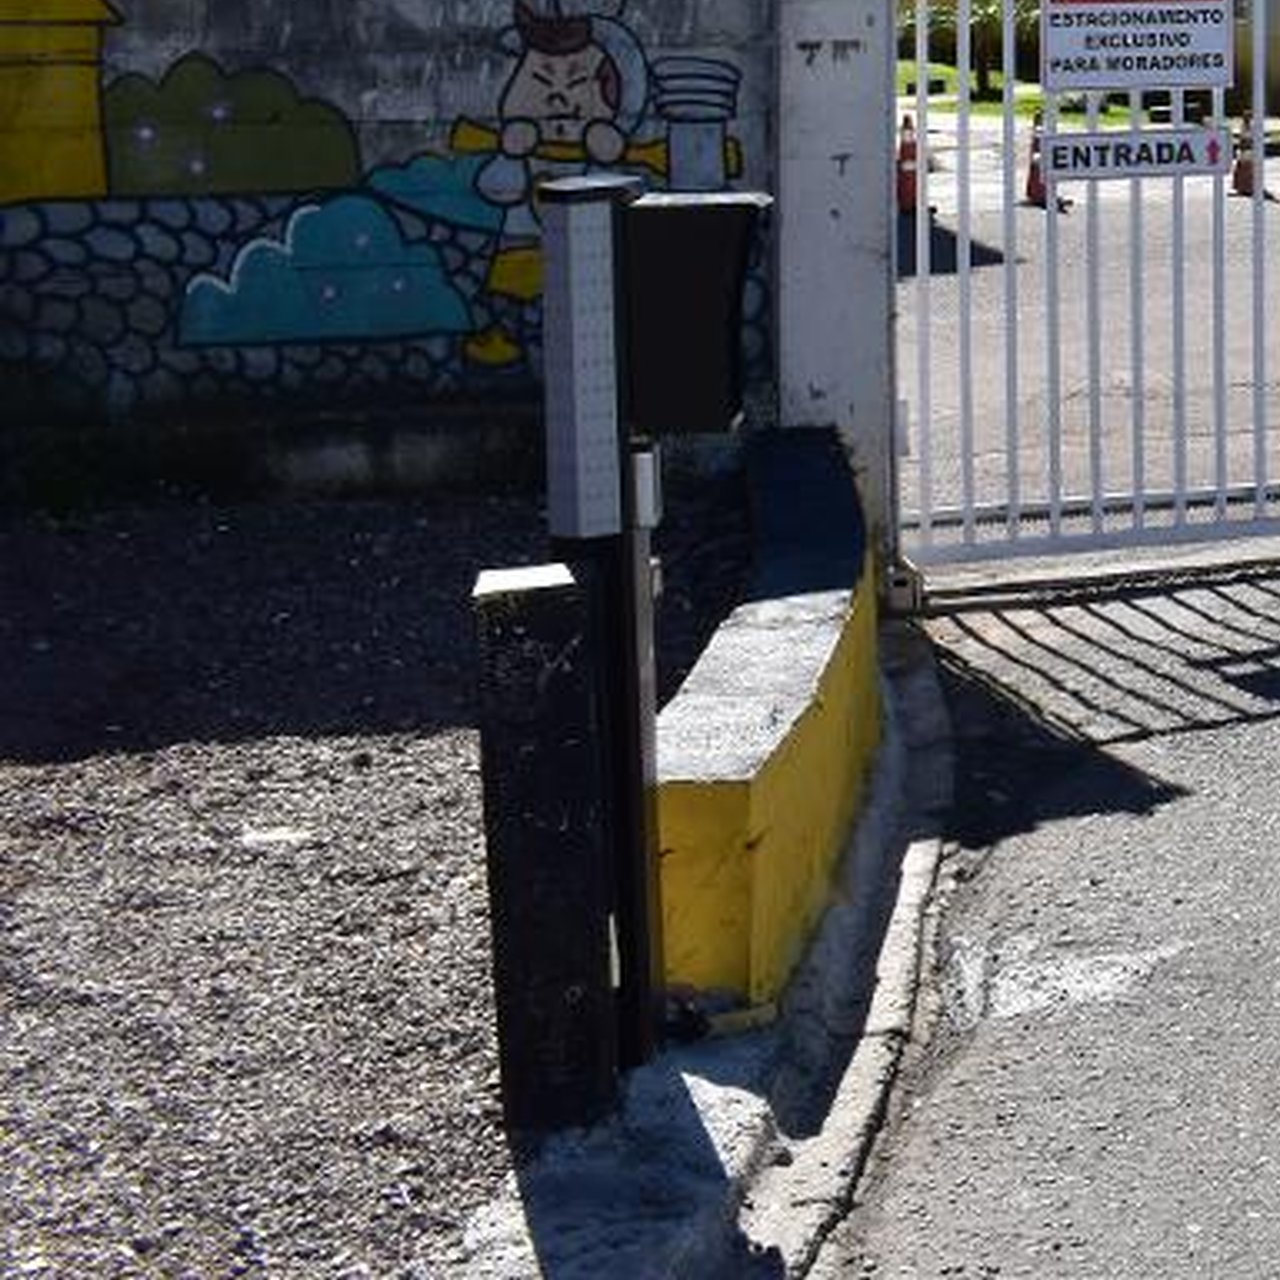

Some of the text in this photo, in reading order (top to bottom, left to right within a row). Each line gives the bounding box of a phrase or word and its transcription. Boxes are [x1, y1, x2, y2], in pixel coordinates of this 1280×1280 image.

[1050, 9, 1224, 28] ESTACIONAMENTO
[1084, 32, 1192, 50] EXCLUSIVO
[1050, 52, 1225, 73] PARA MORADORES
[1051, 141, 1196, 169] ENTRADA
